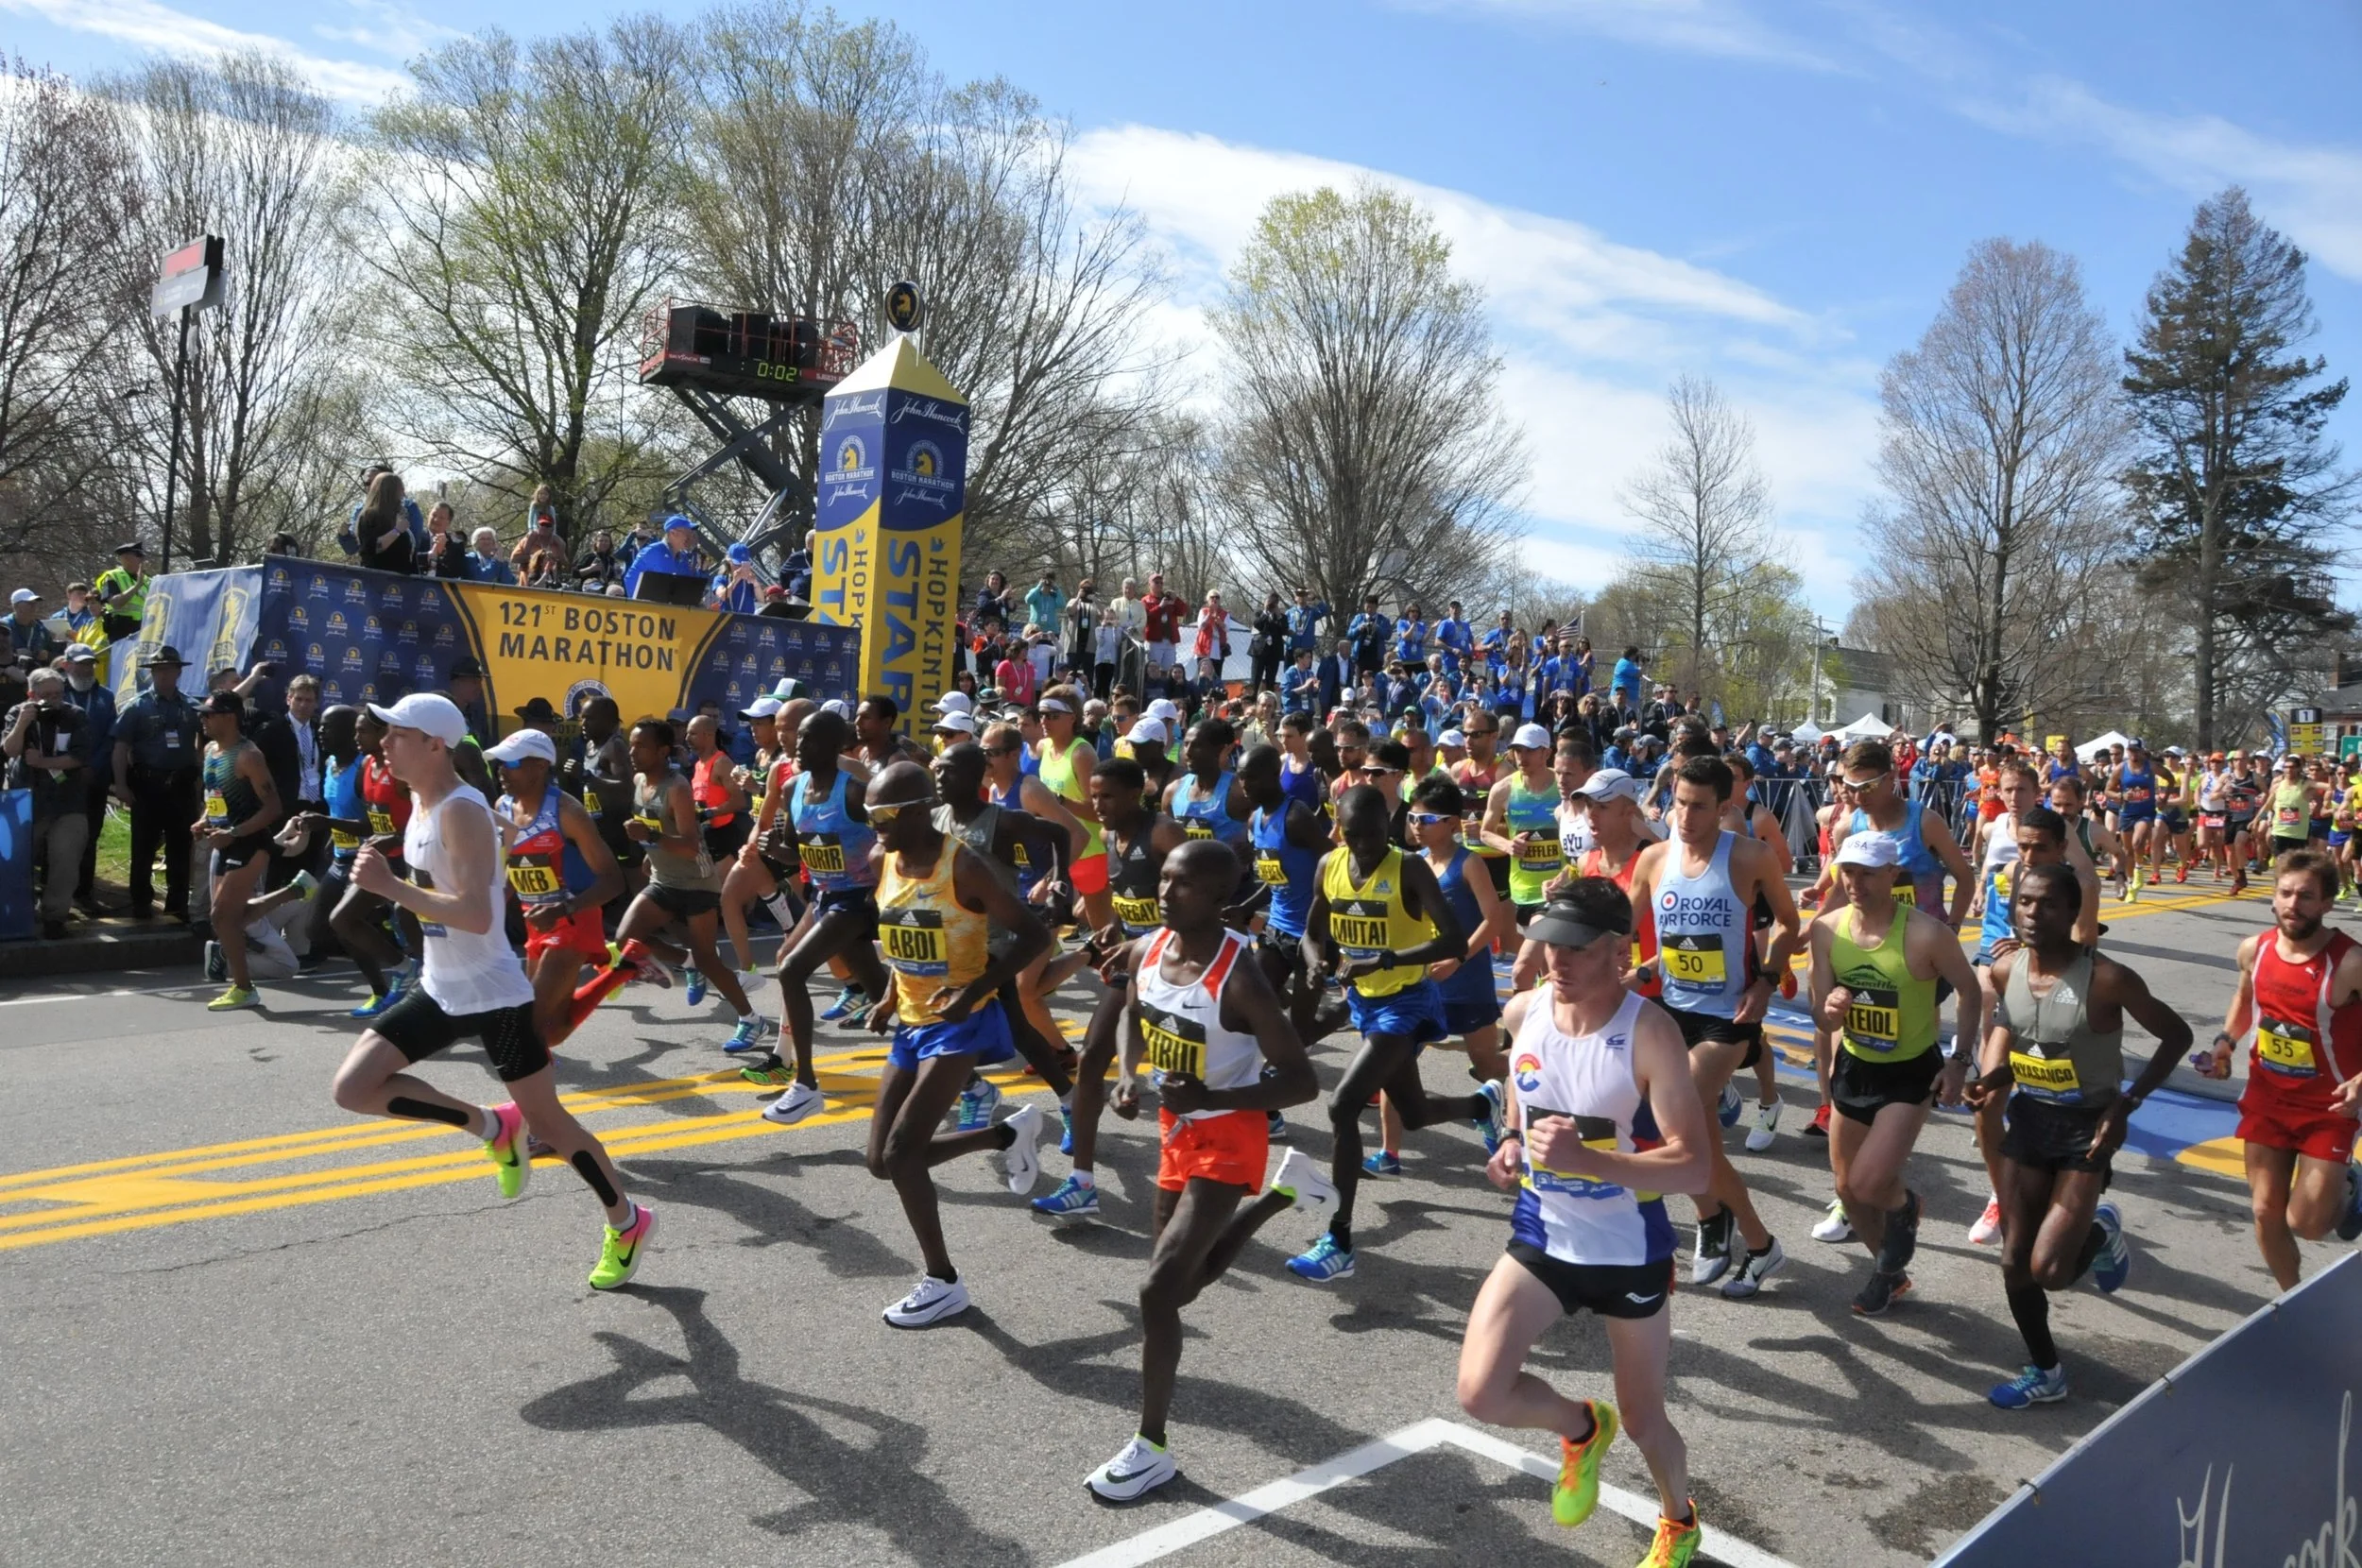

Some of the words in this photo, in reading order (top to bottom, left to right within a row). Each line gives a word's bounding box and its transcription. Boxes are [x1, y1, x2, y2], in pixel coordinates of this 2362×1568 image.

[758, 362, 797, 382] 0:02
[825, 472, 846, 482] BOSTON
[846, 469, 874, 481] MARATHON
[891, 470, 917, 483] BOSTON
[918, 477, 955, 489] MARATHON
[564, 606, 676, 641] BOSTON
[499, 632, 674, 671] MARATHON
[918, 558, 949, 736] HOPKINTON
[1563, 833, 1583, 852] BYU
[1846, 839, 1868, 850] USA
[800, 847, 843, 870] KORIR
[512, 869, 549, 893] MEB
[1680, 897, 1733, 912] ROYAL
[1659, 912, 1678, 927] AIR
[1680, 913, 1732, 928] FORCE
[1333, 916, 1388, 946] MUTAI
[889, 929, 937, 961] ABDI
[1678, 953, 1703, 974] 50
[2271, 1038, 2294, 1058] 55
[2011, 1065, 2074, 1084] NYASANGO
